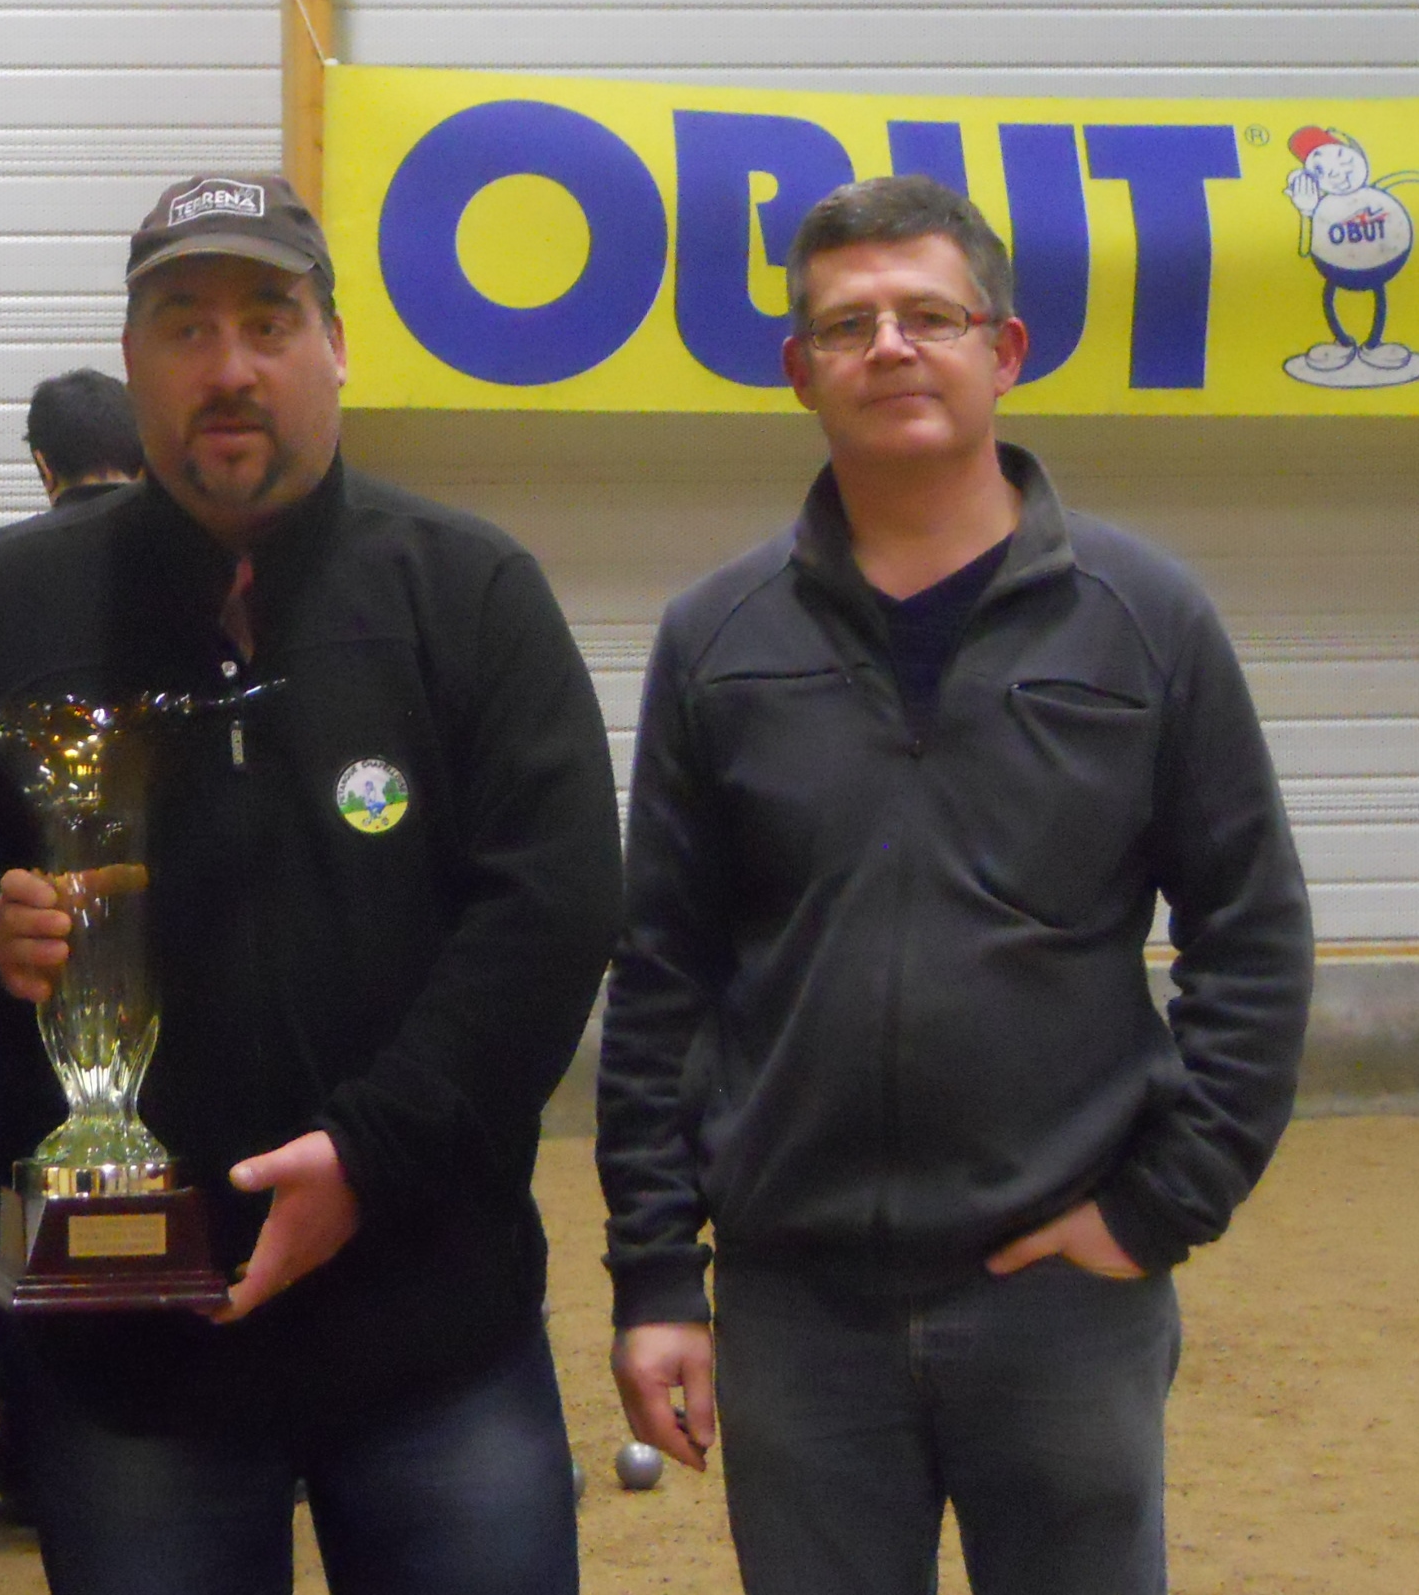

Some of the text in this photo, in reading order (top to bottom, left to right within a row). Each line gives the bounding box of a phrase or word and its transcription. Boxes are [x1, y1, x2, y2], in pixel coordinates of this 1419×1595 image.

[175, 190, 256, 216] TERRENA
[378, 99, 1242, 388] OBUT
[1329, 218, 1386, 245] OBUT
